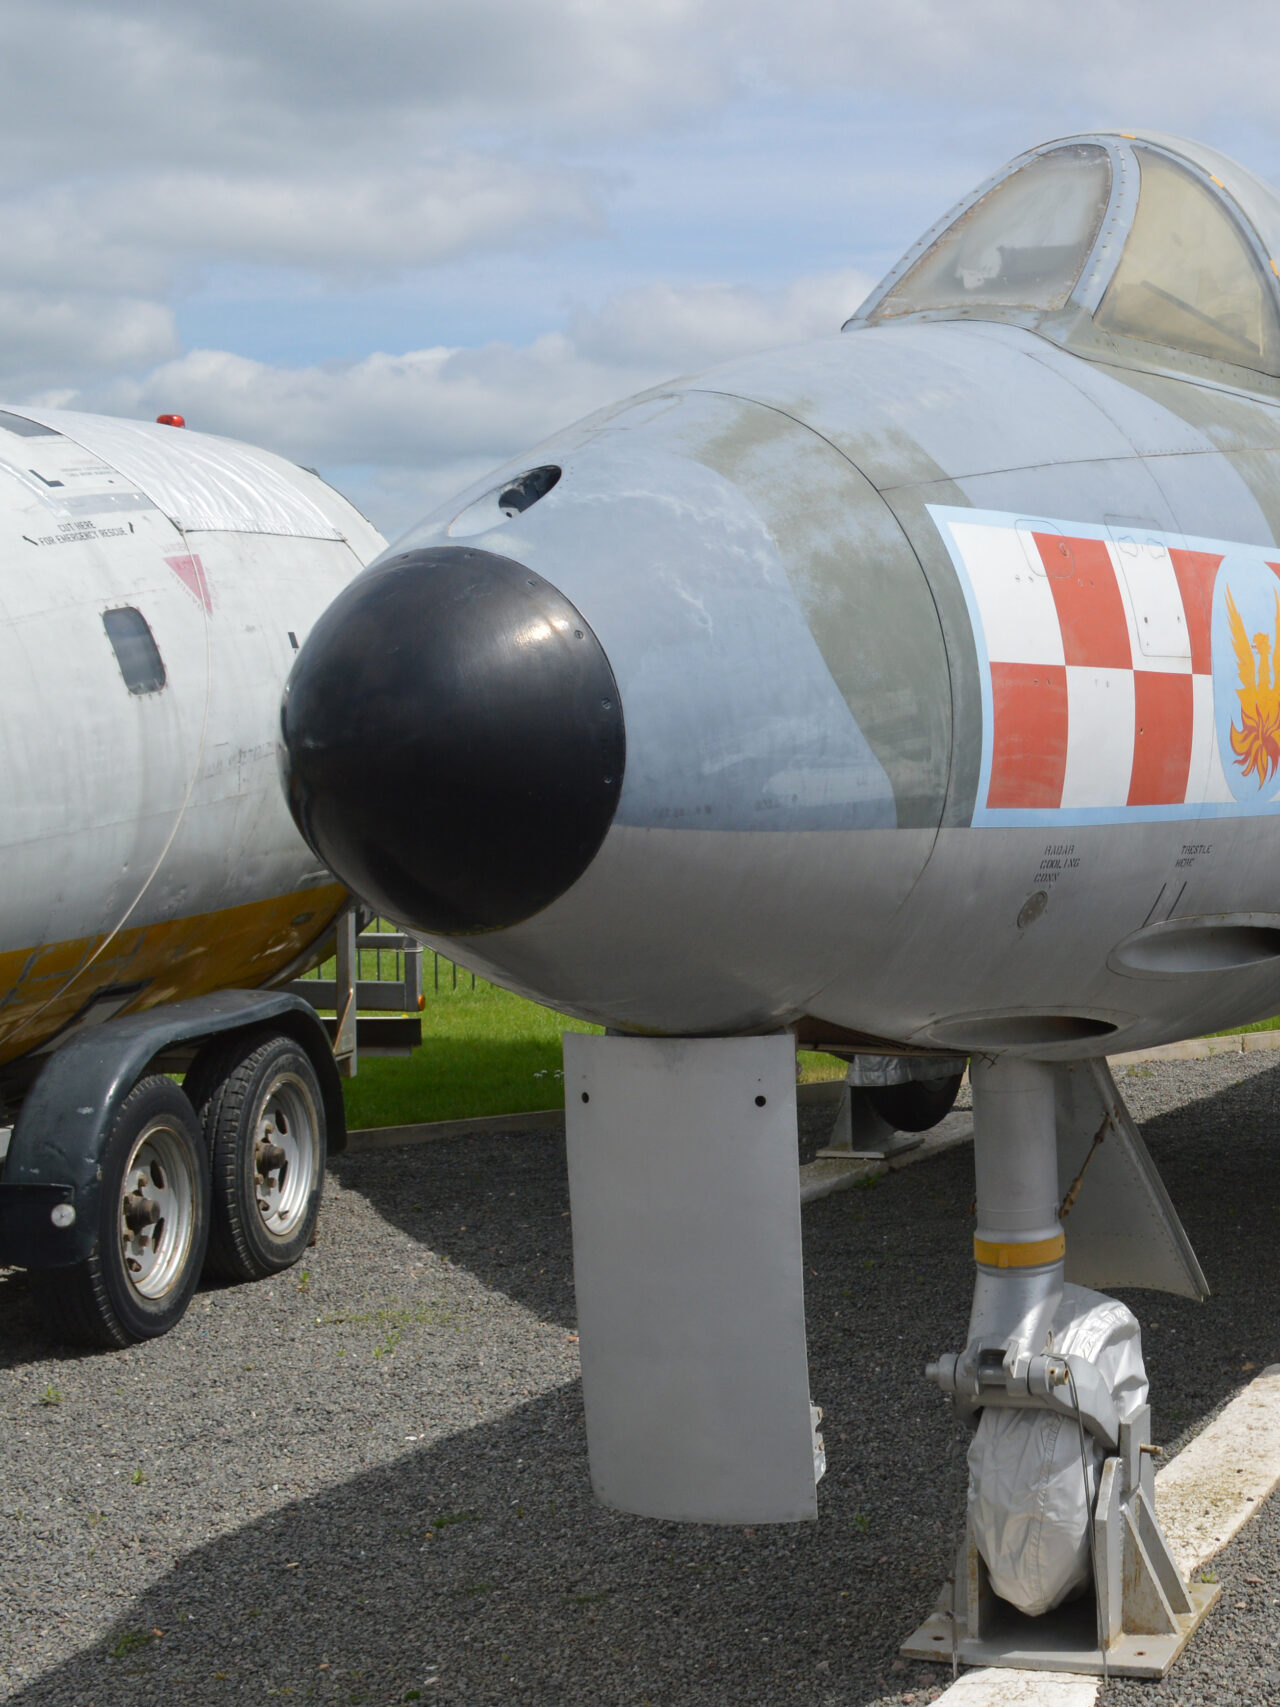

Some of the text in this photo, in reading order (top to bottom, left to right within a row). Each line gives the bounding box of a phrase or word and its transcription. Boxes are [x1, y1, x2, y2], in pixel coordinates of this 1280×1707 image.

[57, 520, 96, 532] CUT HERE
[38, 527, 127, 545] FOR EMERGENCY RESCUE
[1044, 844, 1075, 856] RADAR
[1181, 844, 1213, 855] TRESTLE
[1040, 858, 1081, 869] COOLING
[1175, 858, 1195, 868] HERE
